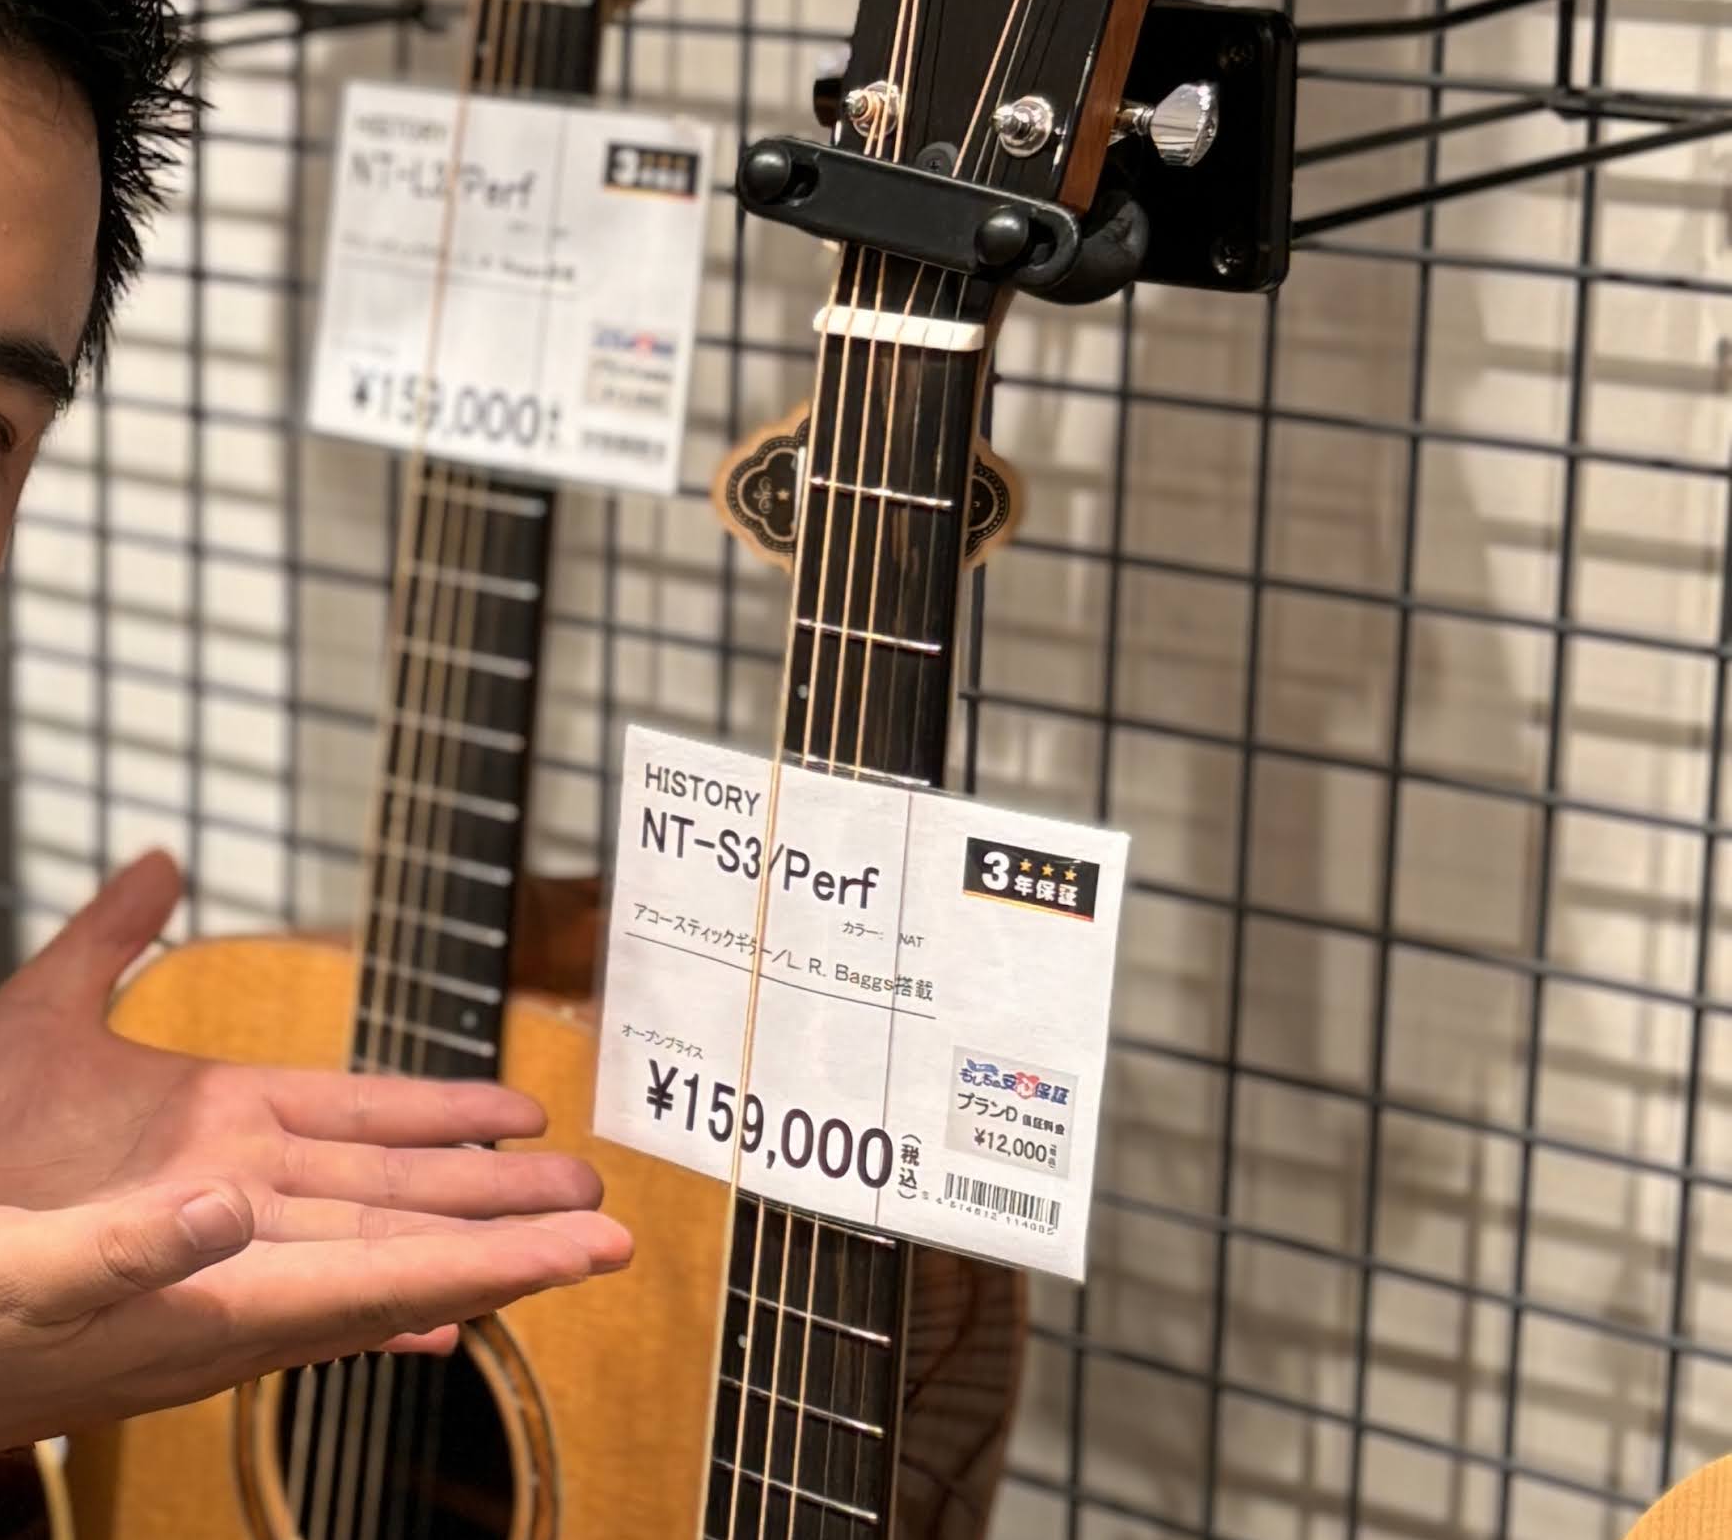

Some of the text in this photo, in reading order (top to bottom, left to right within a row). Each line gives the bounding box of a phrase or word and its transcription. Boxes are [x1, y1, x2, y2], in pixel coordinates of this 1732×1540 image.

[644, 763, 761, 817] HISTORY
[641, 807, 880, 910] NT-S3/Perf
[646, 1059, 894, 1190] ¥159,000
[973, 1126, 1048, 1164] ¥12,000
